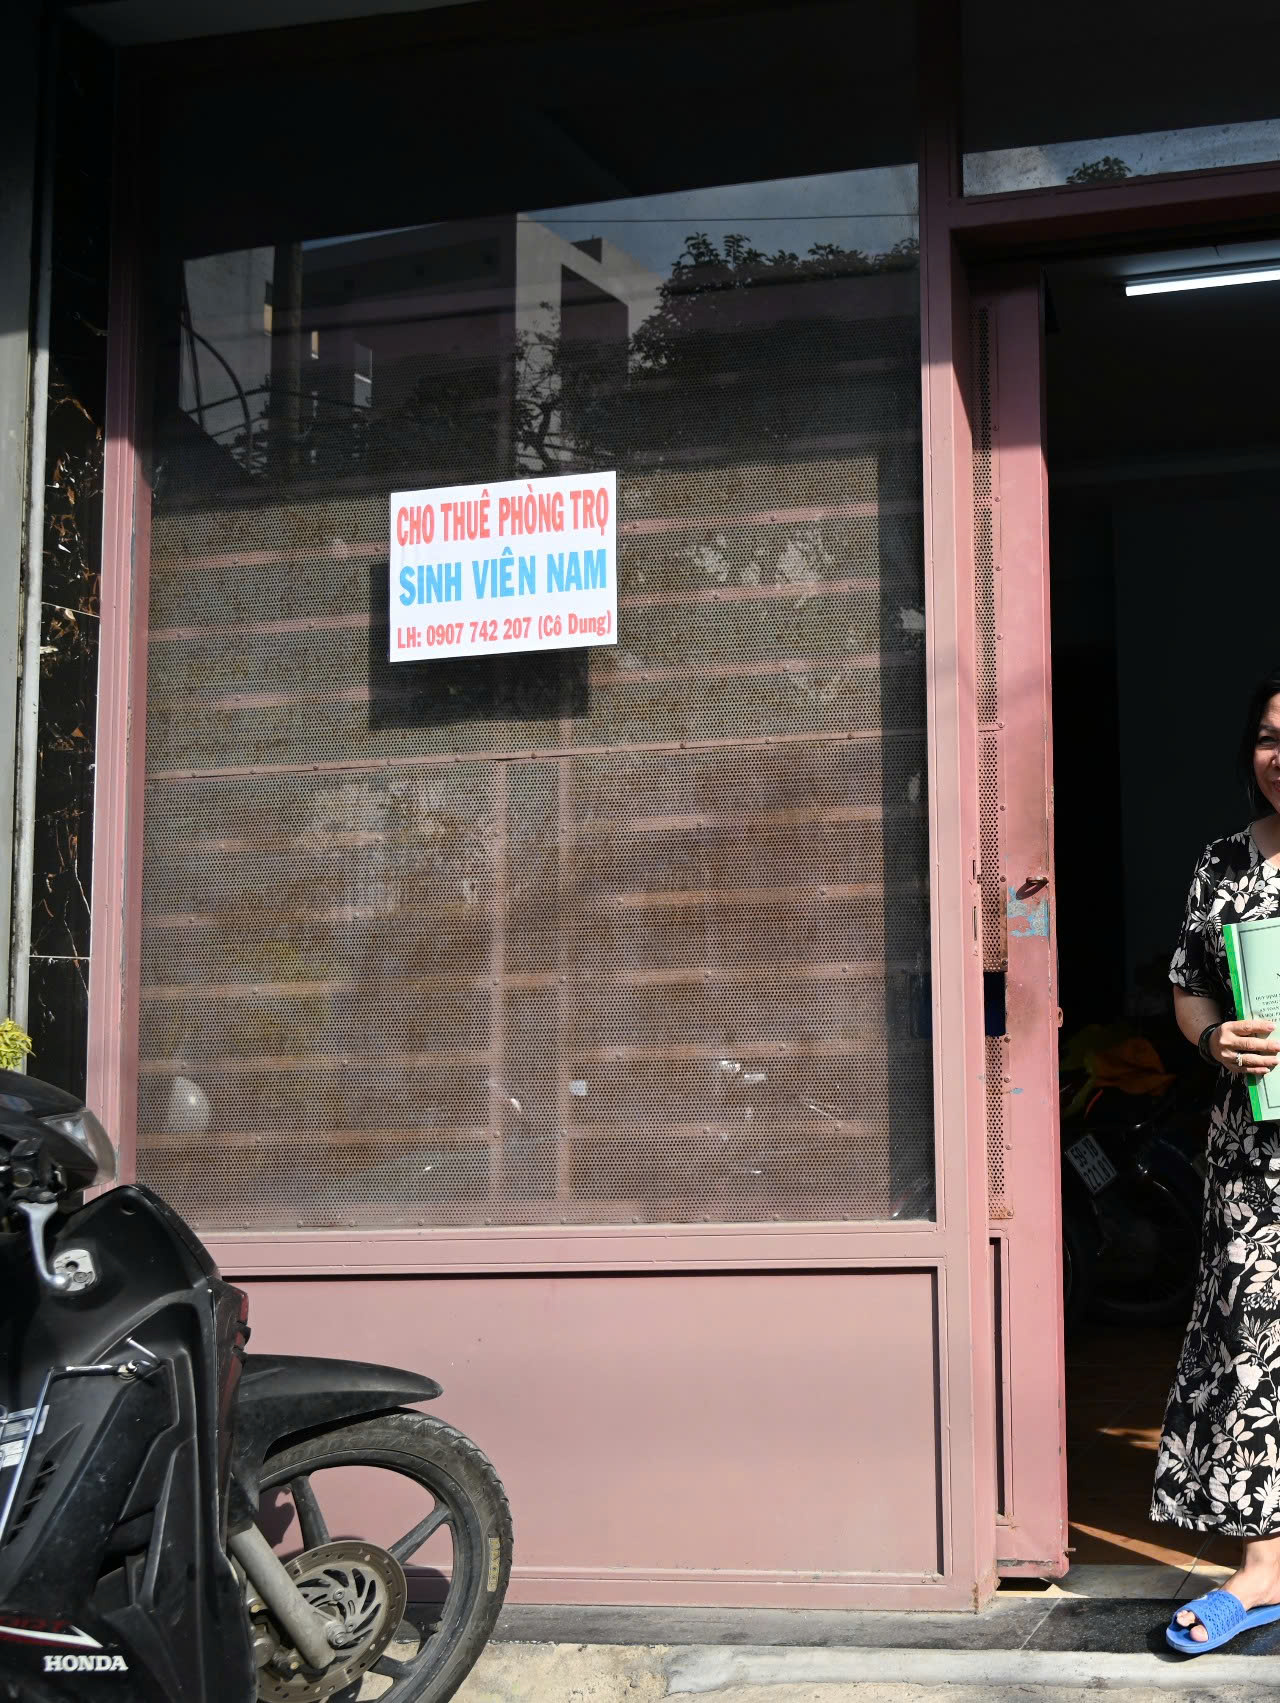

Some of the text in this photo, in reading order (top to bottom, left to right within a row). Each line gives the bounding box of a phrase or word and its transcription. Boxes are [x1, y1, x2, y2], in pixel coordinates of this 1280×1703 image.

[397, 484, 608, 546] CHO THUÊ PHÒNG TRỌ
[400, 546, 606, 606] SINH VIÊN NAM
[398, 610, 611, 648] LH: 0907 742 207 (Cô Dung)
[43, 1655, 129, 1672] HONDA
